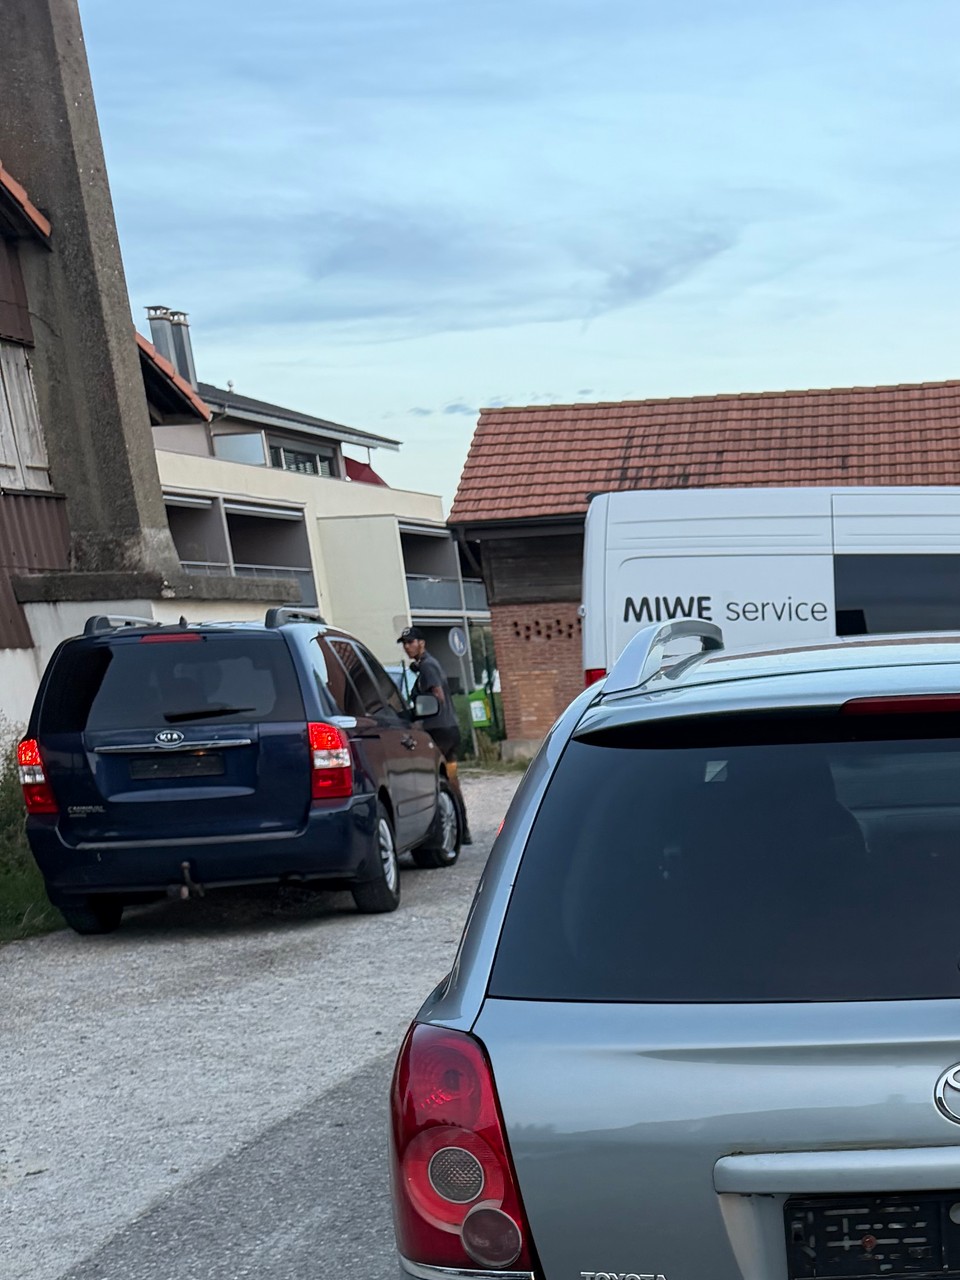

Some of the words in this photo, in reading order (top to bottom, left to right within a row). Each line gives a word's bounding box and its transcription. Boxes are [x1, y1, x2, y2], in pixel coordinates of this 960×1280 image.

[623, 596, 713, 622] MIWE
[726, 596, 828, 621] service
[160, 733, 179, 742] KIA
